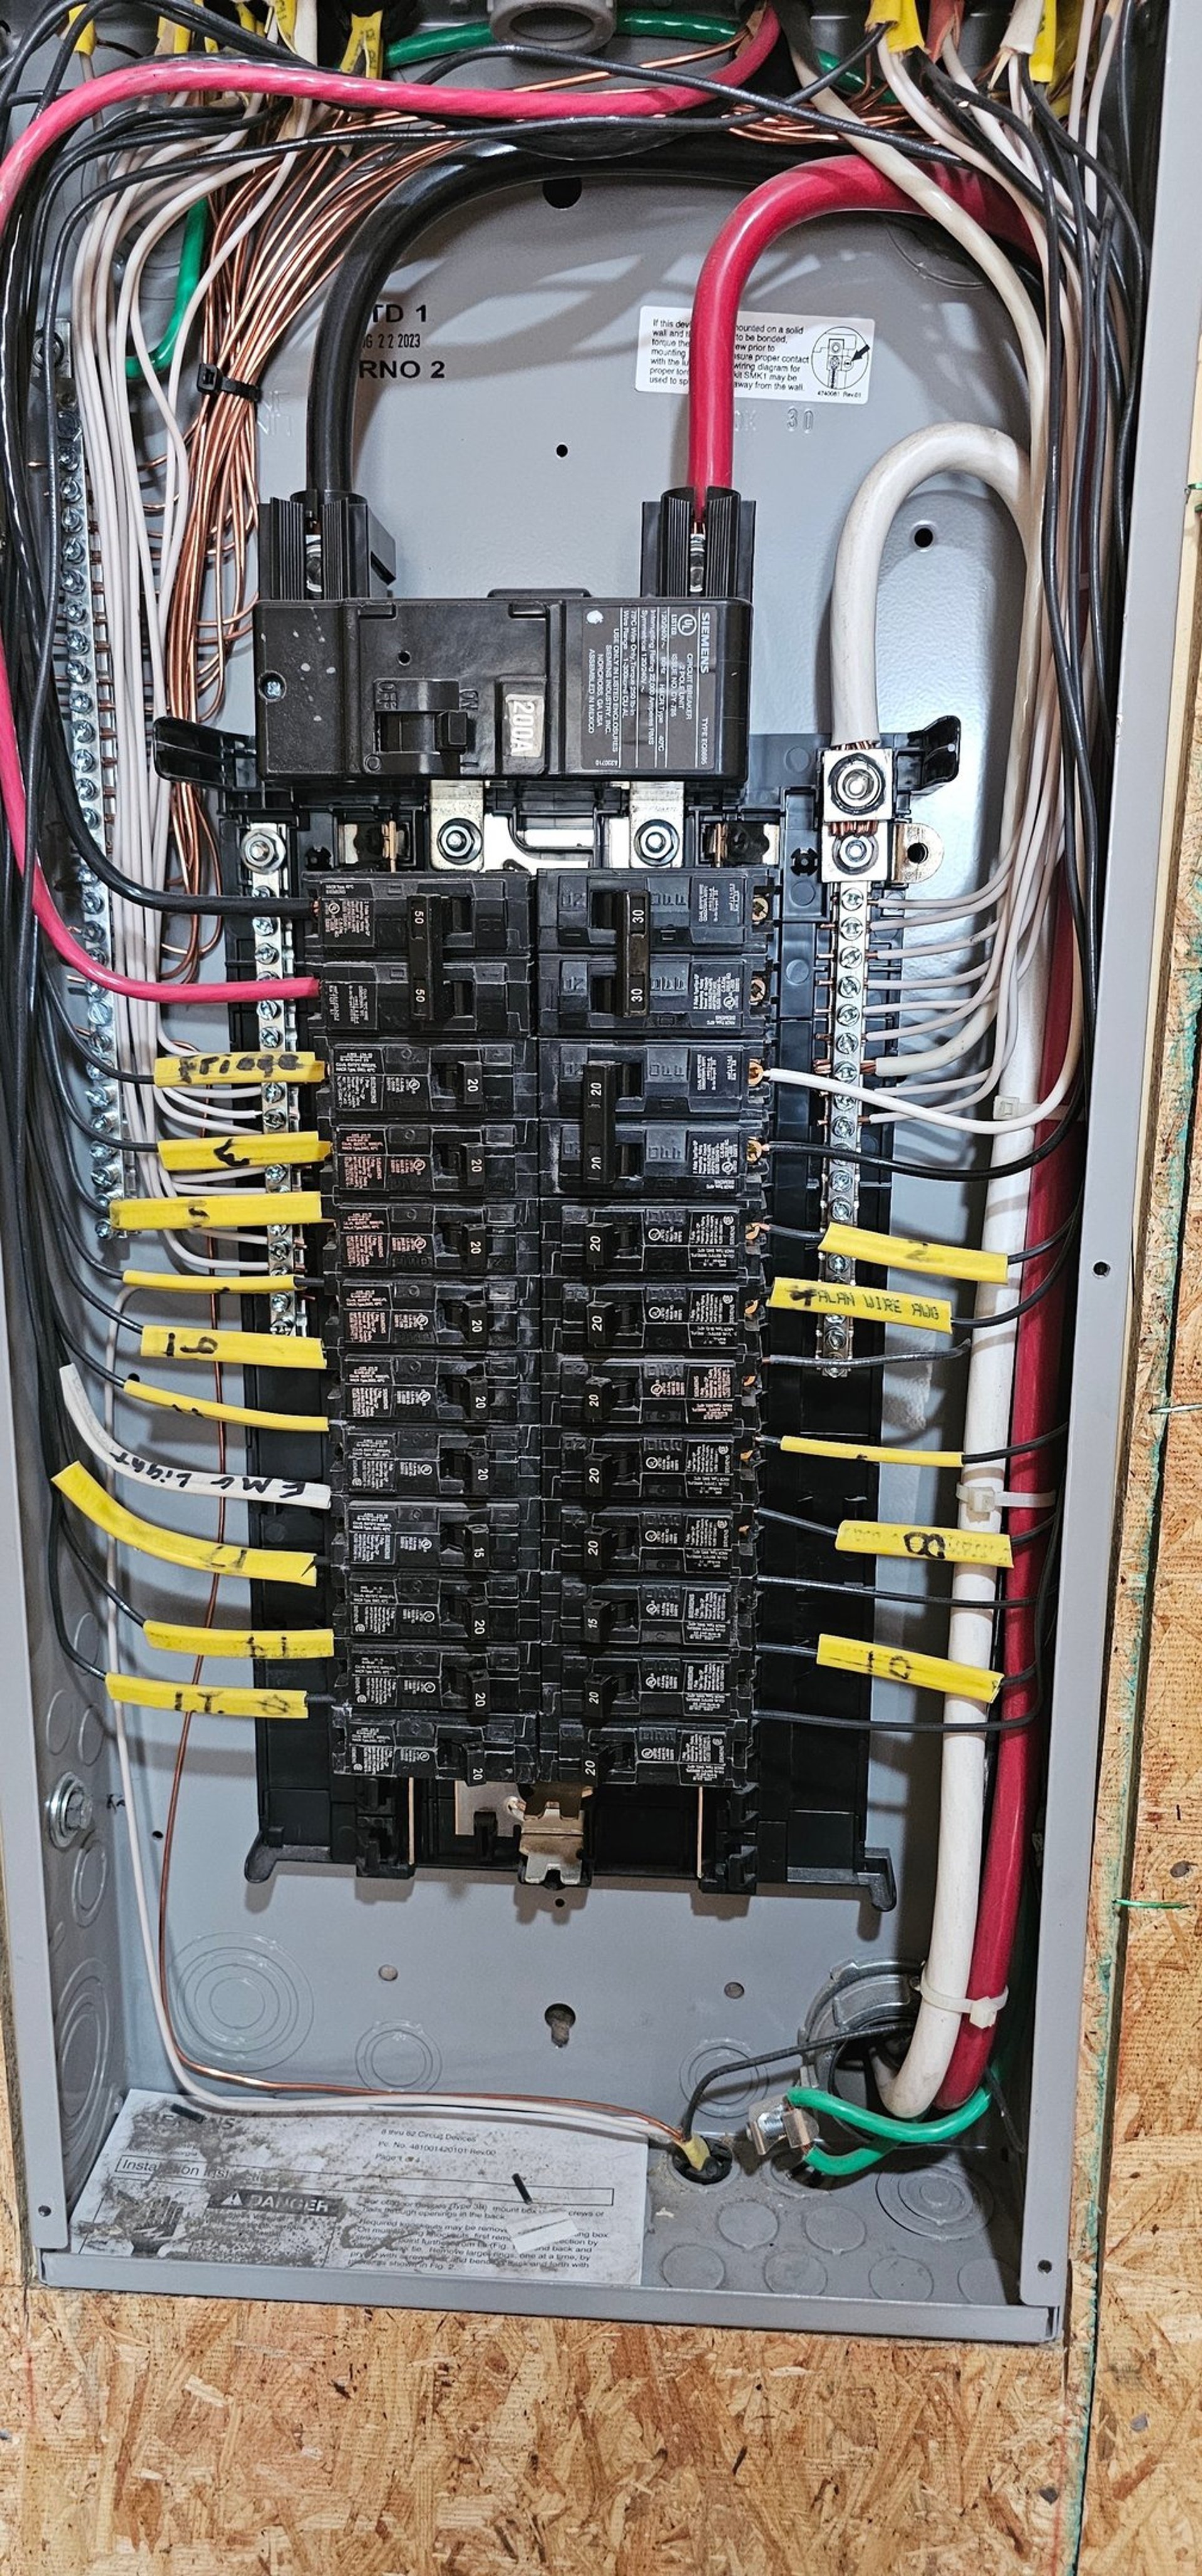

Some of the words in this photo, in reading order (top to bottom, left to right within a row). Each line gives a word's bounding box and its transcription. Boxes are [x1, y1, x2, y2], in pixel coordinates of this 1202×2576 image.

[416, 304, 426, 322] 1
[398, 334, 421, 349] 2023
[652, 339, 677, 347] torque
[748, 343, 766, 352] prior
[651, 348, 686, 359] mounting
[755, 354, 780, 363] proper
[782, 356, 809, 364] contact
[359, 360, 421, 379] RNO
[430, 361, 446, 379] 2
[650, 368, 675, 376] proper
[744, 372, 767, 380] SMK1
[769, 374, 786, 382] may
[734, 364, 756, 374] wiring
[758, 365, 789, 374] diagram
[734, 381, 754, 389] away
[640, 610, 648, 651] Symmetrical
[649, 609, 657, 648] Interrupting
[701, 612, 710, 674] SIEMENS
[614, 666, 619, 674] IN
[597, 698, 604, 710] GA
[647, 696, 655, 726] Amperes
[511, 701, 535, 753] 200A
[414, 910, 424, 925] 50
[632, 909, 644, 924] 30
[415, 989, 425, 1002] 50
[631, 988, 643, 1003] 30
[468, 1078, 478, 1092] 20
[591, 1082, 602, 1096] 20
[472, 1159, 482, 1173] 20
[592, 1157, 602, 1170] 20
[470, 1240, 481, 1254] 20
[590, 1235, 600, 1252] 20
[863, 1294, 902, 1314] WIRE
[911, 1302, 939, 1320] AWG
[471, 1319, 482, 1333] 20
[592, 1316, 603, 1332] 20
[475, 1396, 486, 1409] 20
[589, 1394, 600, 1408] 20
[478, 1468, 488, 1481] 20
[589, 1468, 600, 1484] 20
[474, 1547, 485, 1558] 15
[588, 1540, 598, 1556] 20
[475, 1620, 485, 1635] 20
[588, 1617, 598, 1629] 15
[475, 1692, 486, 1707] 20
[589, 1691, 600, 1704] 20
[473, 1768, 483, 1781] 20
[585, 1759, 595, 1776] 20
[445, 2133, 477, 2143] Devices
[376, 2153, 398, 2161] Page
[249, 2193, 330, 2213] DANGER
[492, 2205, 520, 2213] mount
[418, 2210, 458, 2218] openings
